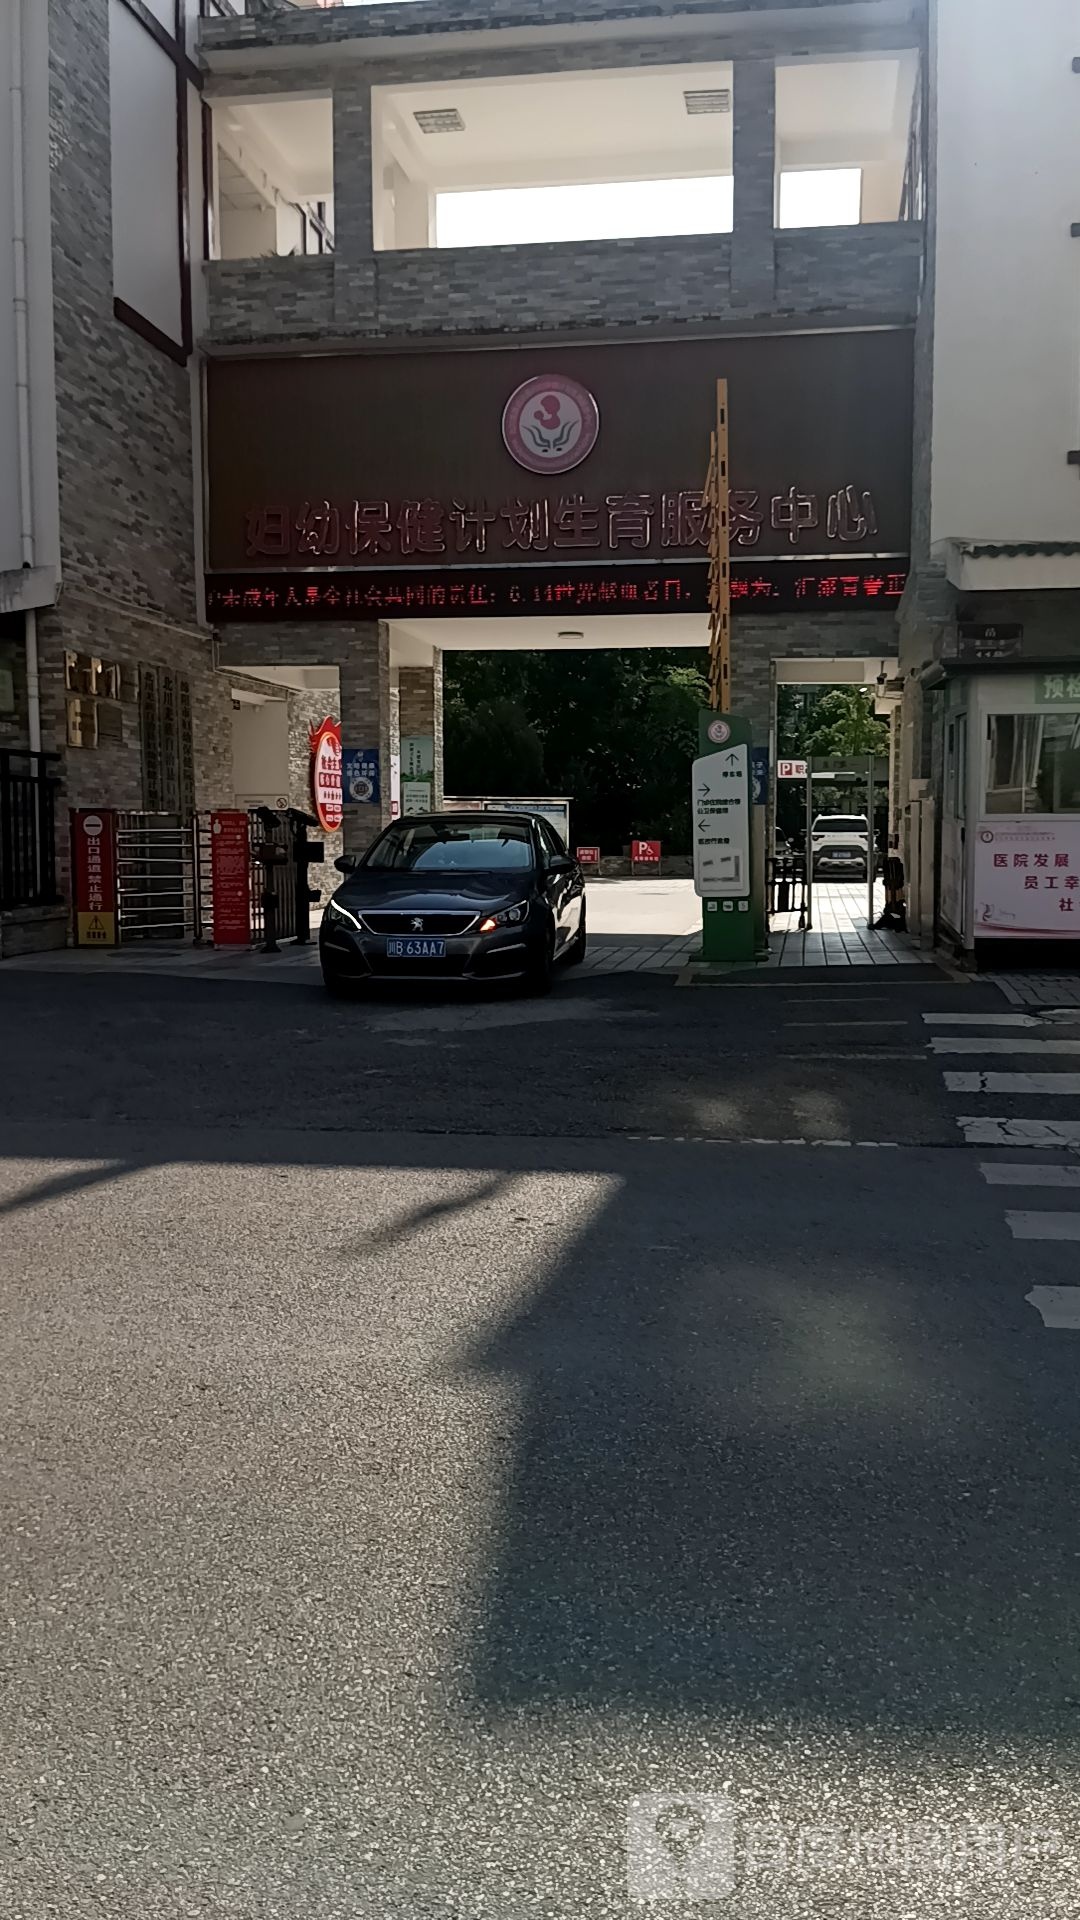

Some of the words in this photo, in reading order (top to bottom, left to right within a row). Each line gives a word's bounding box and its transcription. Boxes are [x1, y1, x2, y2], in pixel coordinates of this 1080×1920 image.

[246, 484, 879, 556] 妇幼保健计划生育服务中心
[993, 853, 1069, 868] 医院发展
